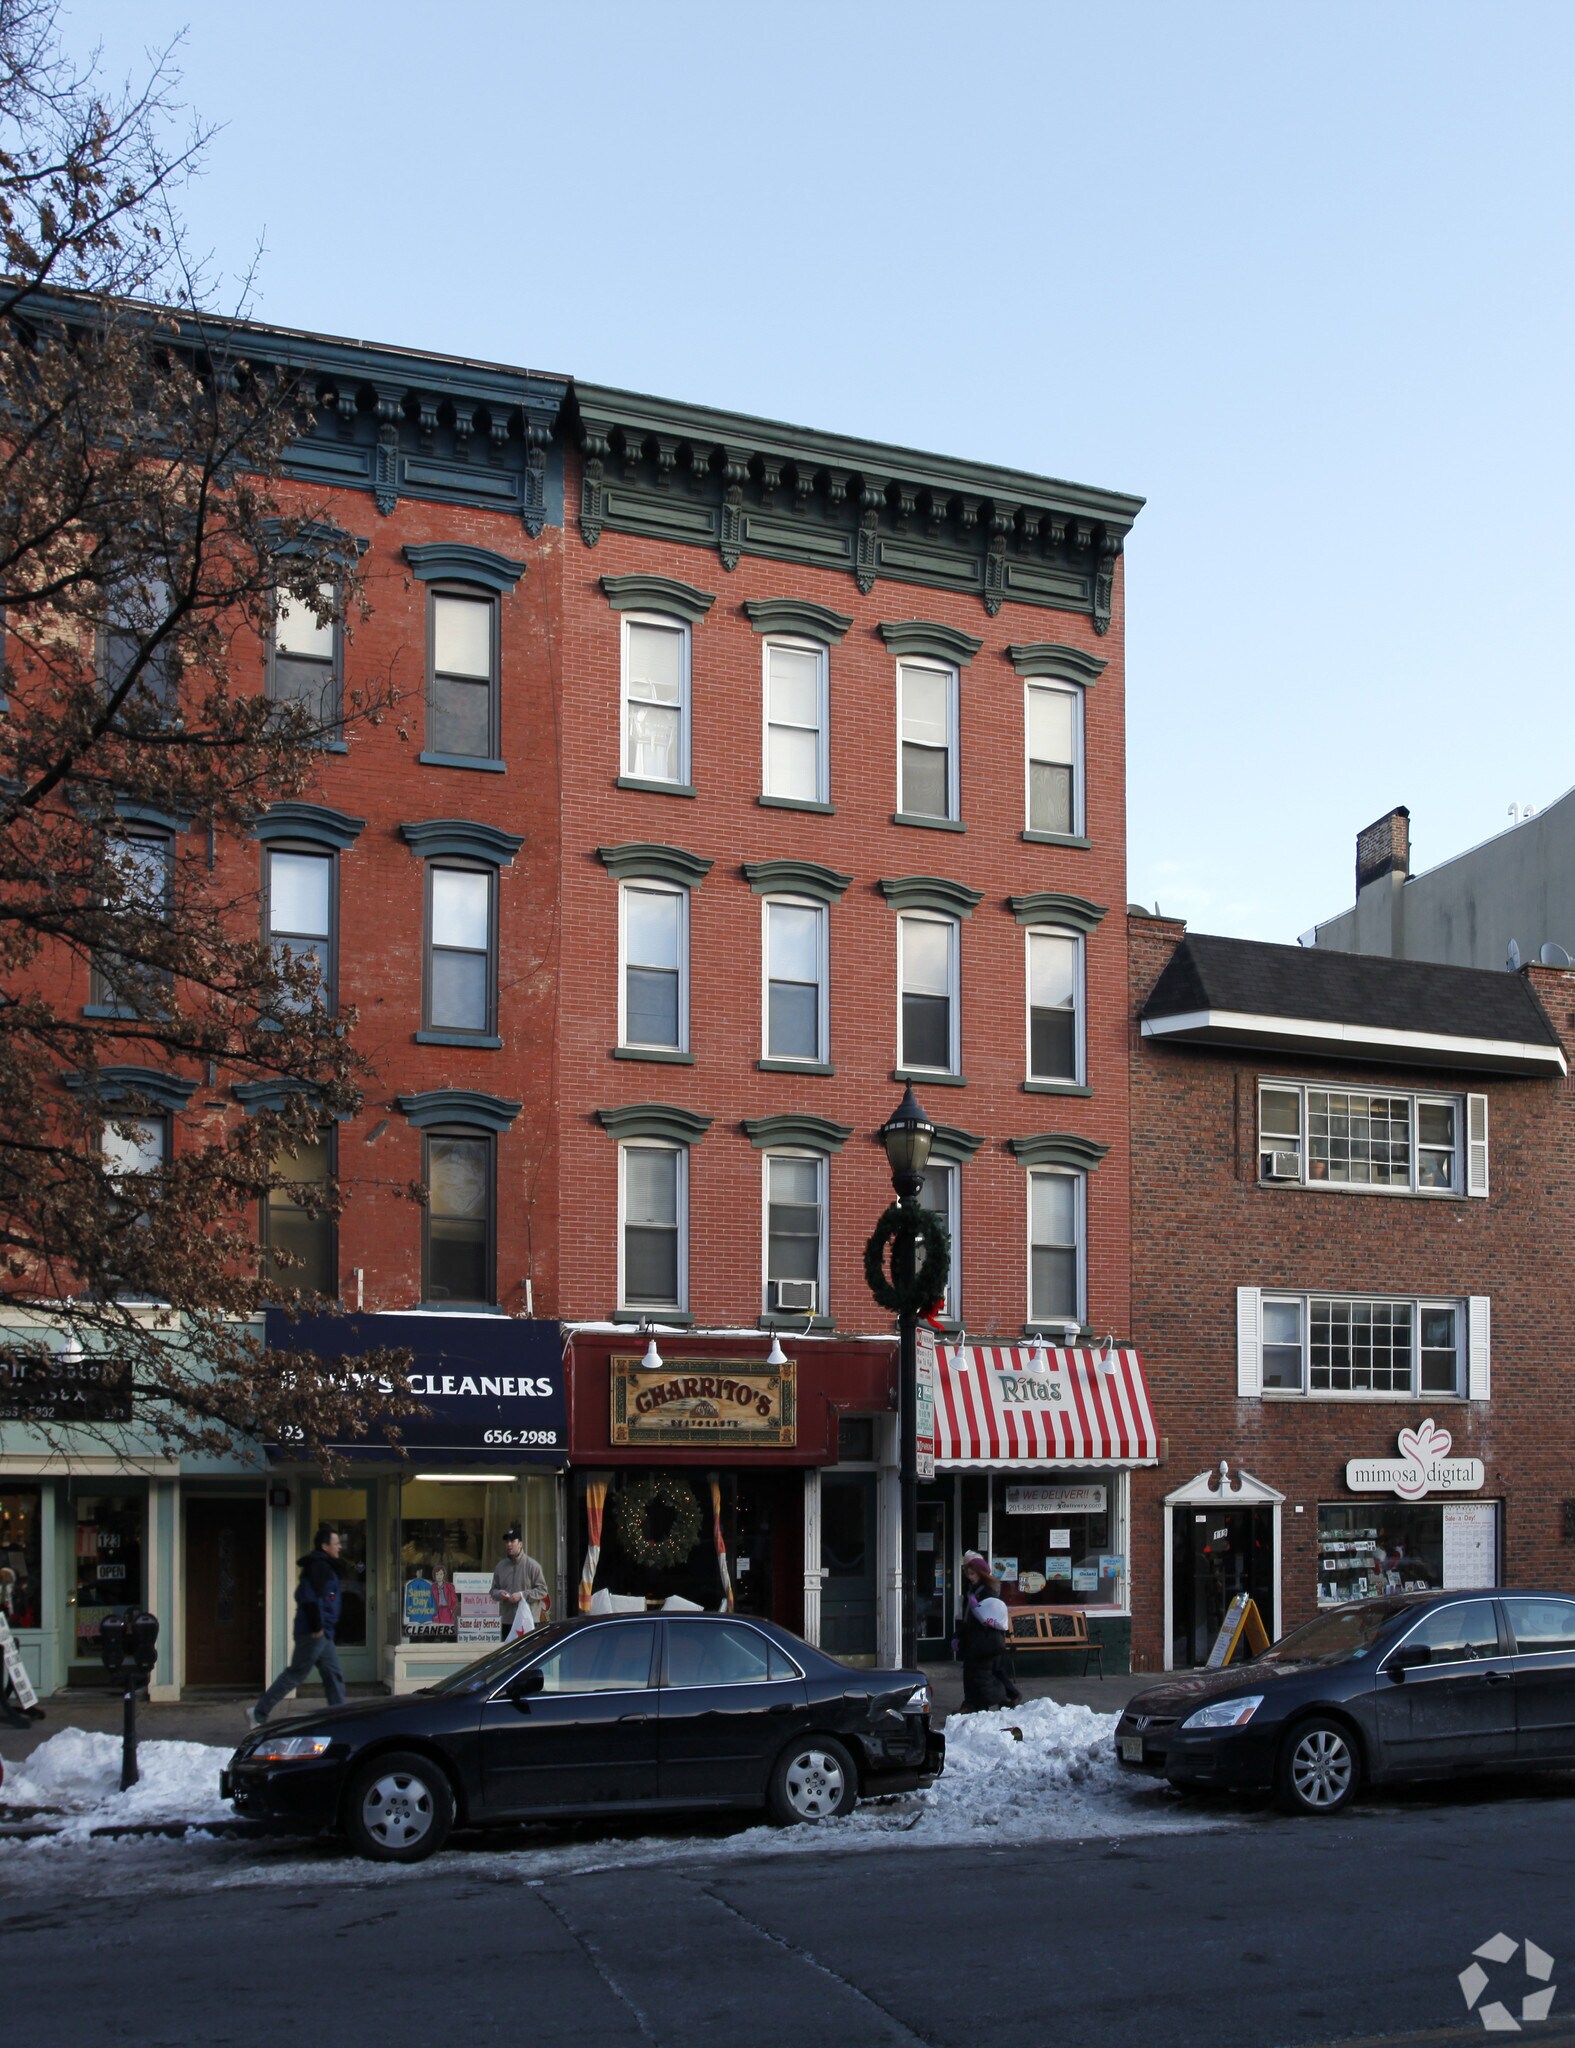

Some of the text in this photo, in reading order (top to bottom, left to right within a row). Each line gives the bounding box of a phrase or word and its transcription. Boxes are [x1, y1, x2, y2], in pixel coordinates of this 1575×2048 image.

[405, 1374, 554, 1397] CLEANERS
[998, 1375, 1062, 1402] Rita's
[635, 1377, 772, 1417] CHARRITO'S
[484, 1430, 557, 1444] 656-2988
[1355, 1461, 1474, 1488] mimosa digital
[1023, 1489, 1089, 1500] WE DELIVER!!
[98, 1534, 120, 1548] 123
[100, 1567, 124, 1577] OPEN
[409, 1588, 431, 1597] Same
[412, 1598, 429, 1608] Day
[407, 1607, 435, 1616] Service
[459, 1618, 500, 1630] Same day Service
[405, 1625, 455, 1636] CLEANERS
